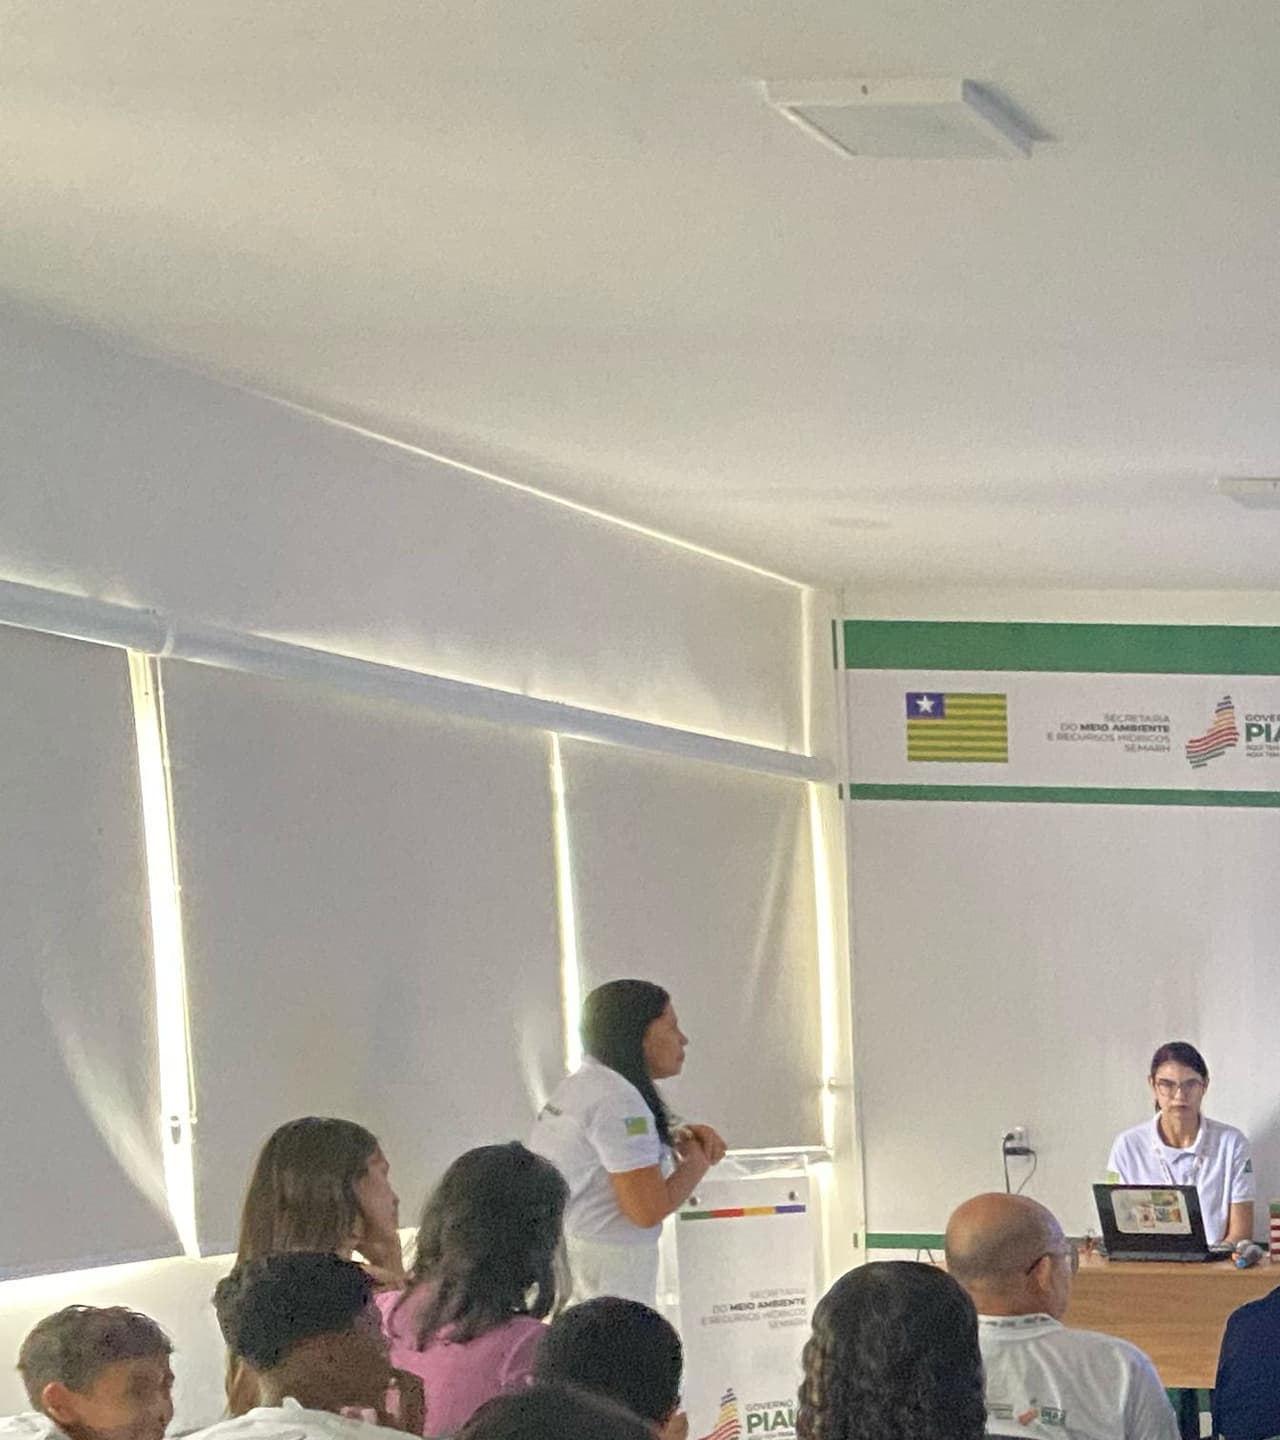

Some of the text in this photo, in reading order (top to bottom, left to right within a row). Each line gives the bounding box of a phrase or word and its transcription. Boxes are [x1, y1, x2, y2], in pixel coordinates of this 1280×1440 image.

[1080, 723, 1109, 732] MEIO
[1112, 724, 1170, 733] AMBIENTE
[729, 1302, 755, 1311] MEIO
[757, 1297, 806, 1309] AMBIENTE
[746, 1400, 793, 1412] GOVERNO
